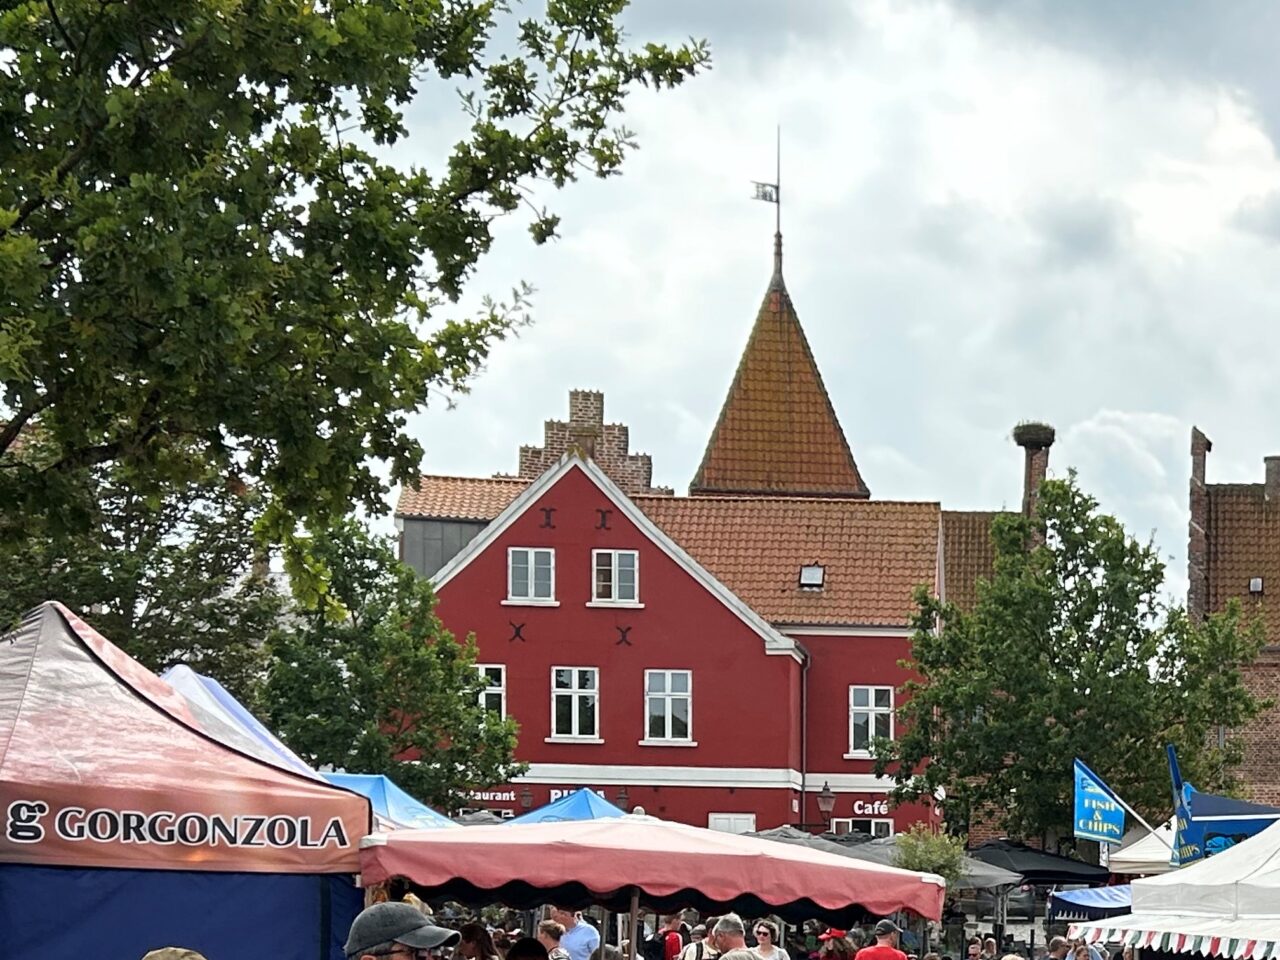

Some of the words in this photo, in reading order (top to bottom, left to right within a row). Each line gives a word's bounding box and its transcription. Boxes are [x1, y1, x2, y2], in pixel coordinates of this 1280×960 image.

[448, 789, 516, 801] taurant
[853, 800, 889, 815] Café
[1084, 799, 1116, 812] FISH
[1093, 810, 1102, 821] &
[56, 807, 349, 848] GORGONZOLA
[1079, 819, 1120, 835] CHIPS
